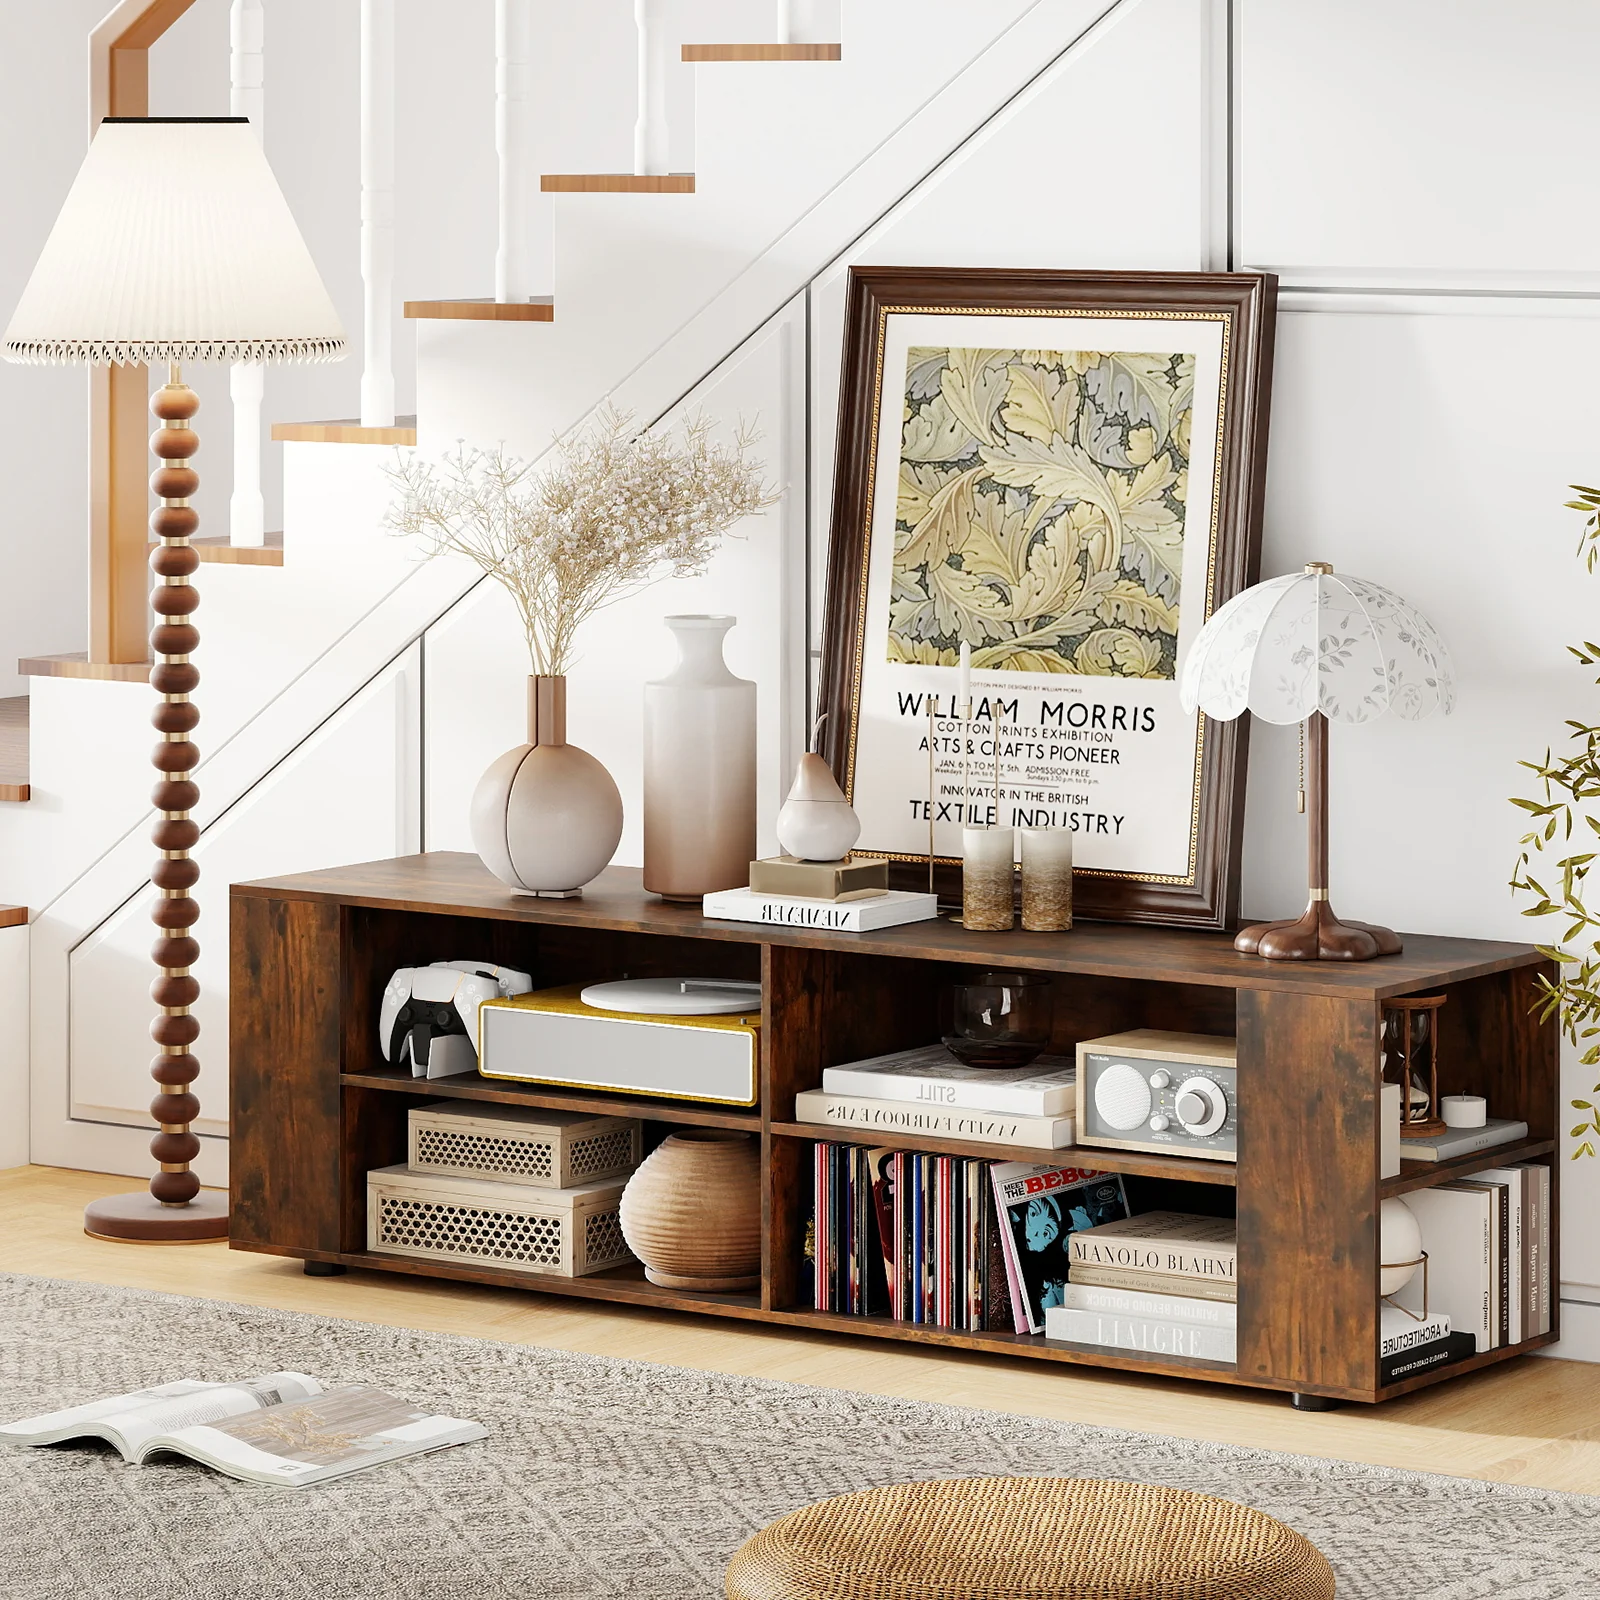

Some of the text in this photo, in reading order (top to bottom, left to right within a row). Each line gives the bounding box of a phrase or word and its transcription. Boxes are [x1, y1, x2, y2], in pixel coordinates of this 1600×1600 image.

[1040, 700, 1156, 733] MORRIS
[937, 721, 991, 735] COTTON
[1042, 728, 1114, 743] EXHIBITION
[918, 736, 1121, 765] ARTS & CRAFTS PIONEER
[935, 767, 962, 776] Weekdays
[940, 760, 957, 768] JAN.
[958, 761, 972, 769] 6h
[974, 761, 986, 770] TO
[987, 763, 1004, 771] MY
[1025, 765, 1069, 776] ADMISSION
[1070, 768, 1090, 778] FREE
[1027, 773, 1049, 782] Sundays
[940, 784, 1089, 805] INNOVATOR IN THE BRITISH
[909, 799, 1125, 835] TEXTILE INDUSTRY
[1003, 1180, 1024, 1192] MEET
[1024, 1166, 1109, 1194] BEBO
[1005, 1187, 1025, 1200] THE
[1073, 1241, 1235, 1278] MANOLO BLAHNÍ
[1136, 1280, 1150, 1288] Greek
[1151, 1282, 1171, 1292] Religion
[1530, 1243, 1538, 1312] Мартин Иден
[1086, 1293, 1129, 1310] POLLOCK
[1502, 1287, 1508, 1298] из
[1132, 1299, 1171, 1316] BEYOND
[1174, 1303, 1219, 1322] PAINTING
